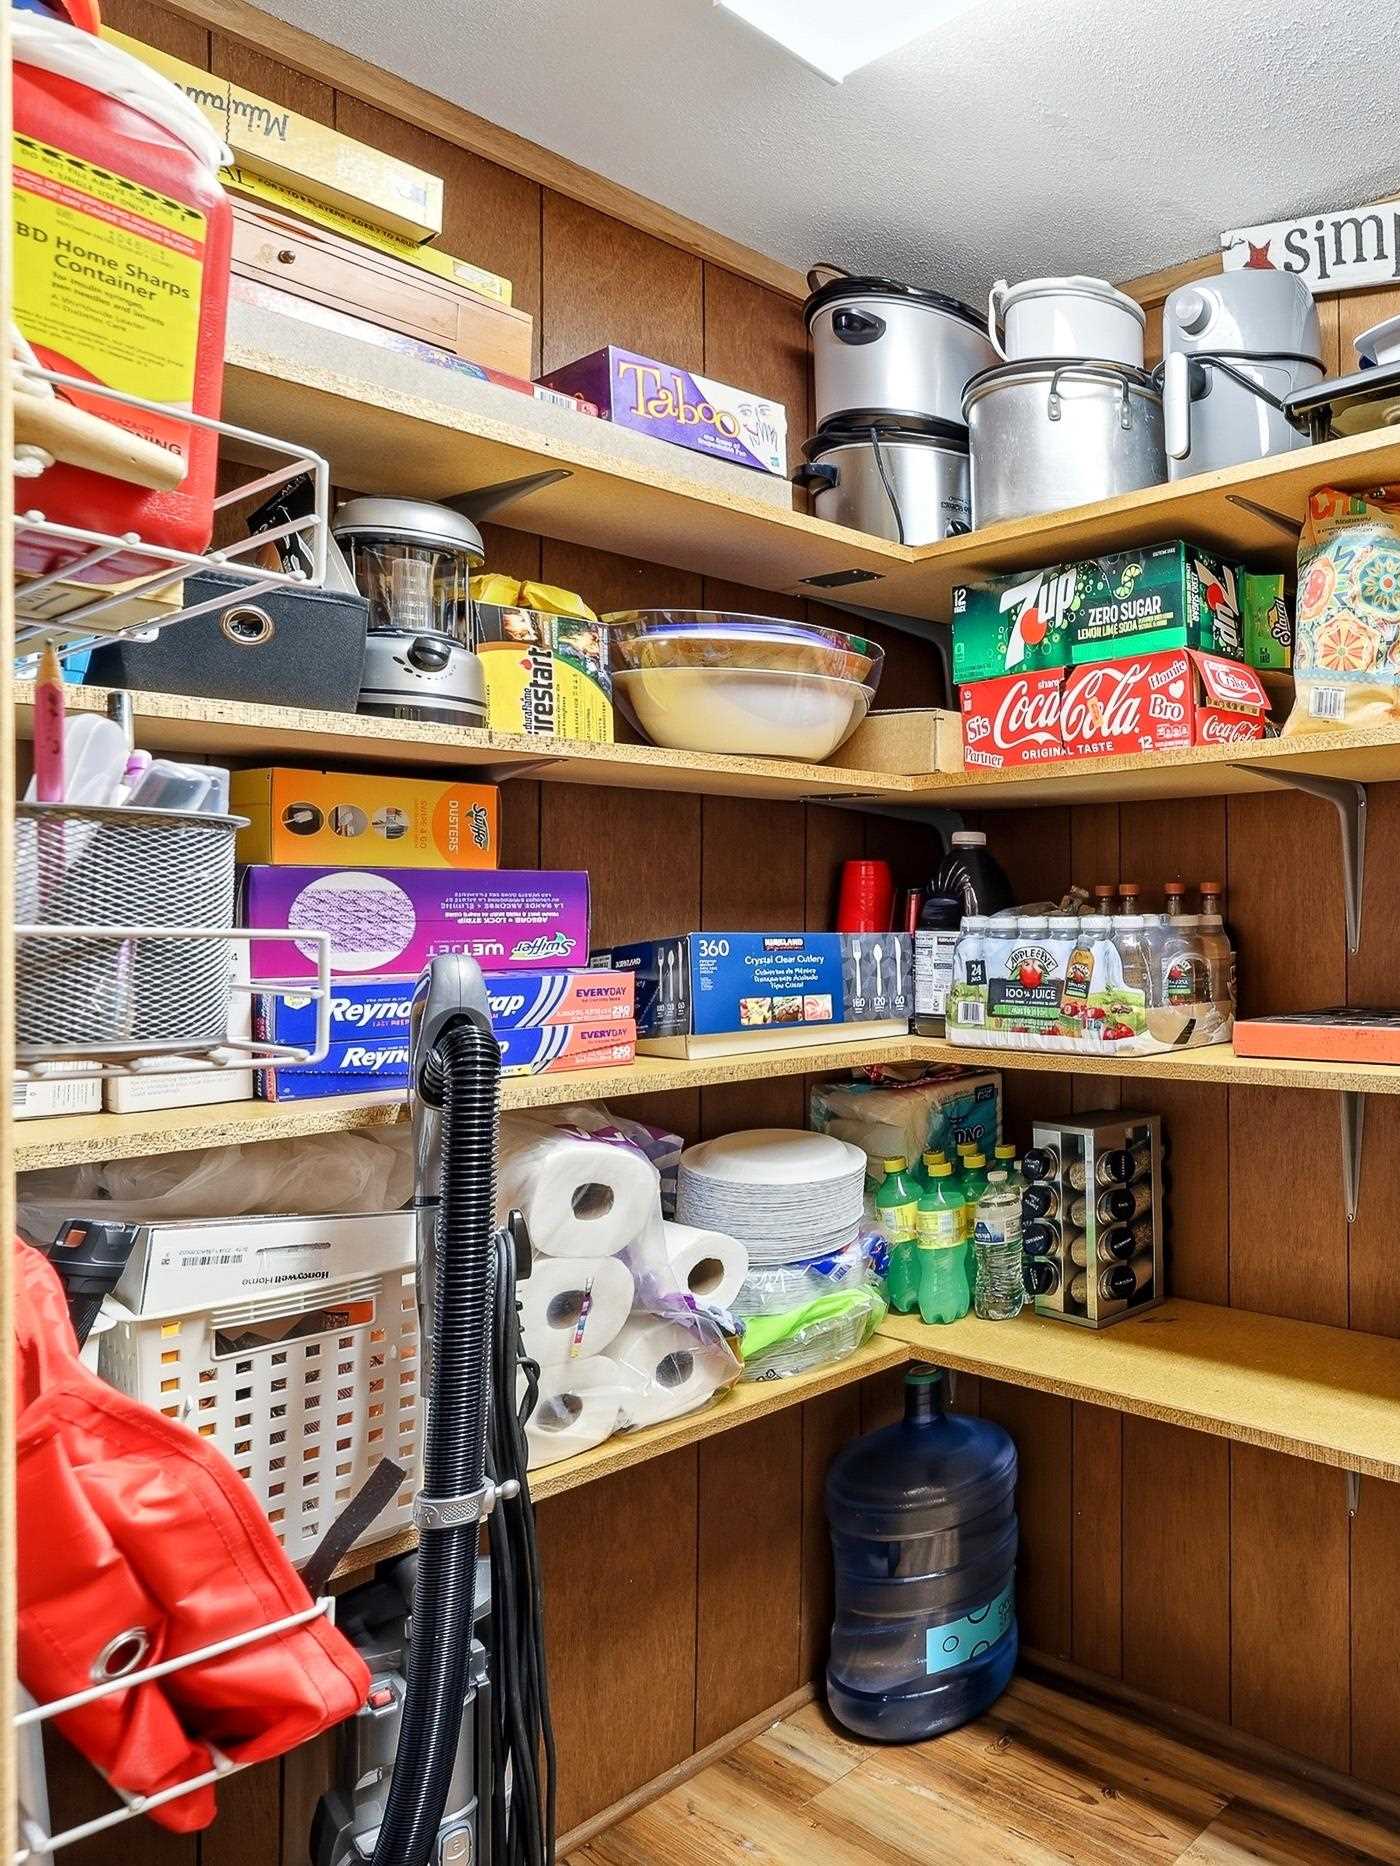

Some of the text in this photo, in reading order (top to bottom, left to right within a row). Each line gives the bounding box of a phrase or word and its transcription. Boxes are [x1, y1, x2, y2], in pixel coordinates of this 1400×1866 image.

[16, 221, 191, 299] BD Home Sharps
[55, 254, 157, 301] Container
[618, 362, 739, 439] Taboo
[954, 588, 967, 601] 12
[1088, 595, 1162, 627] ZERO SUGAR
[1078, 627, 1102, 640] LEMON
[1119, 620, 1138, 634] SODA
[1150, 660, 1187, 688] Homie
[528, 647, 554, 735] irestart
[522, 688, 532, 730] duraflame
[1152, 696, 1183, 719] Bro
[967, 715, 990, 741] Sis
[966, 748, 1002, 767] Partner
[1022, 741, 1114, 760] ORIGINAL TASTE
[449, 800, 459, 851] DUSTERS
[470, 803, 488, 849] Swiffer
[513, 937, 577, 961] Swiffer
[699, 939, 730, 957] 360
[764, 938, 804, 946] KIRKLAND
[744, 955, 824, 966] Crystal Clear Cutlery
[971, 964, 981, 976] 24
[487, 991, 525, 1016] rap
[576, 987, 626, 998] EVERYDAY
[895, 996, 905, 1005] 60
[1031, 987, 1056, 1000] JUICE
[330, 998, 412, 1027] Reyno
[580, 1029, 628, 1040] EVERYDAY
[340, 1047, 409, 1071] Reyn
[241, 1270, 329, 1287] Honeywell Home
